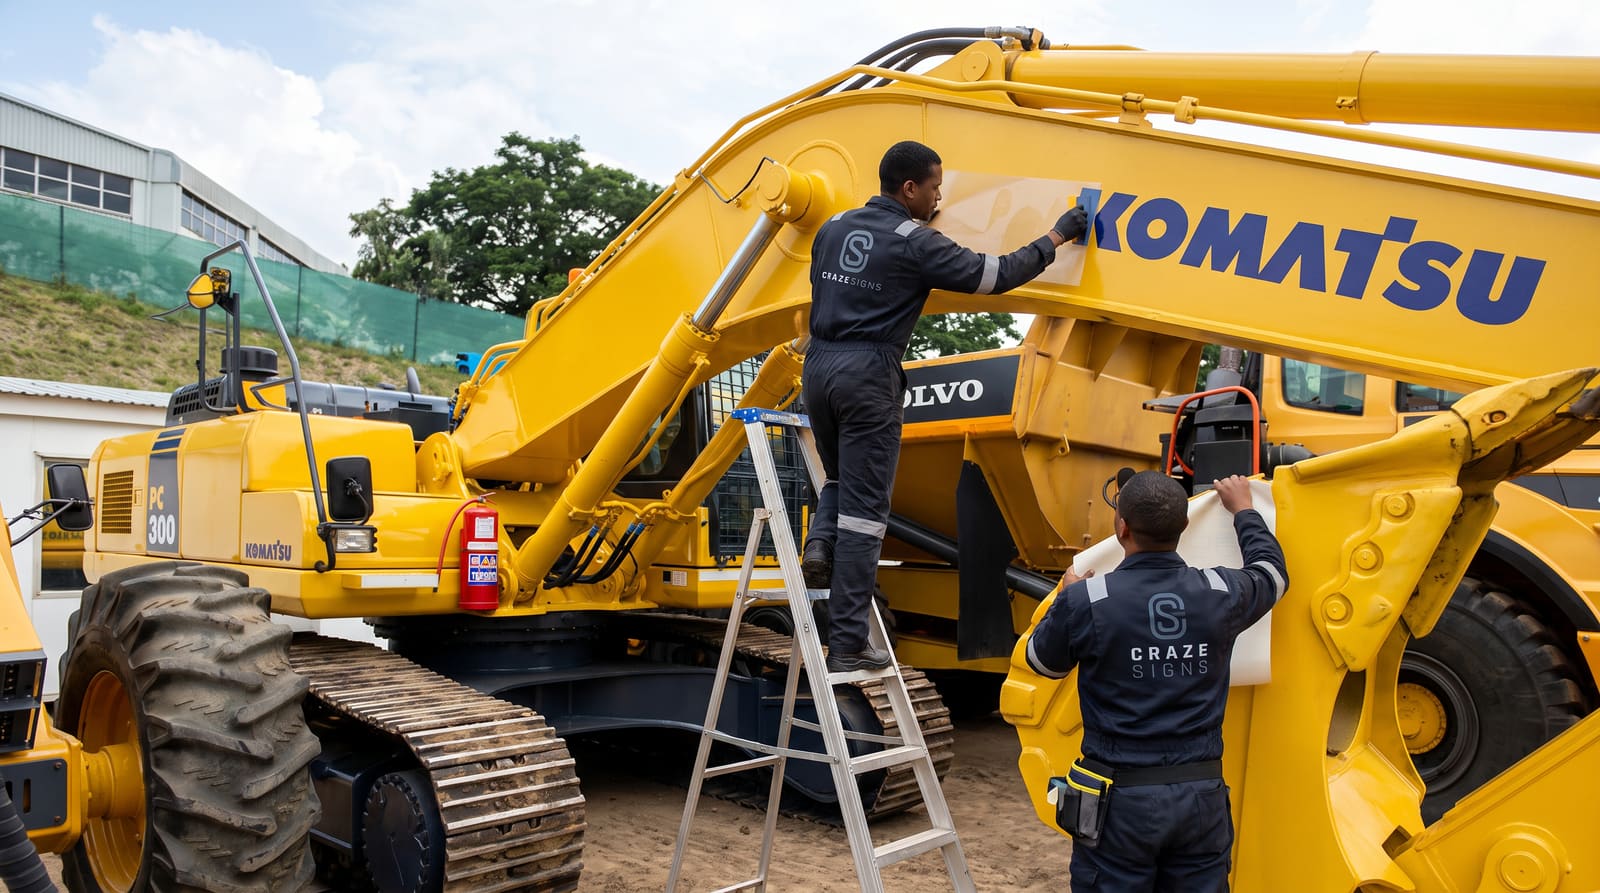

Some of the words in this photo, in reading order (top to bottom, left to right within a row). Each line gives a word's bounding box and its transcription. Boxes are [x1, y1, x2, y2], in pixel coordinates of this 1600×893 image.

[1076, 187, 1547, 326] KOMATSU
[149, 485, 165, 510] PC
[148, 514, 176, 545] 300
[245, 540, 292, 561] KOMATSU
[1130, 643, 1209, 661] CRAZE
[1132, 660, 1208, 679] SIGNS
